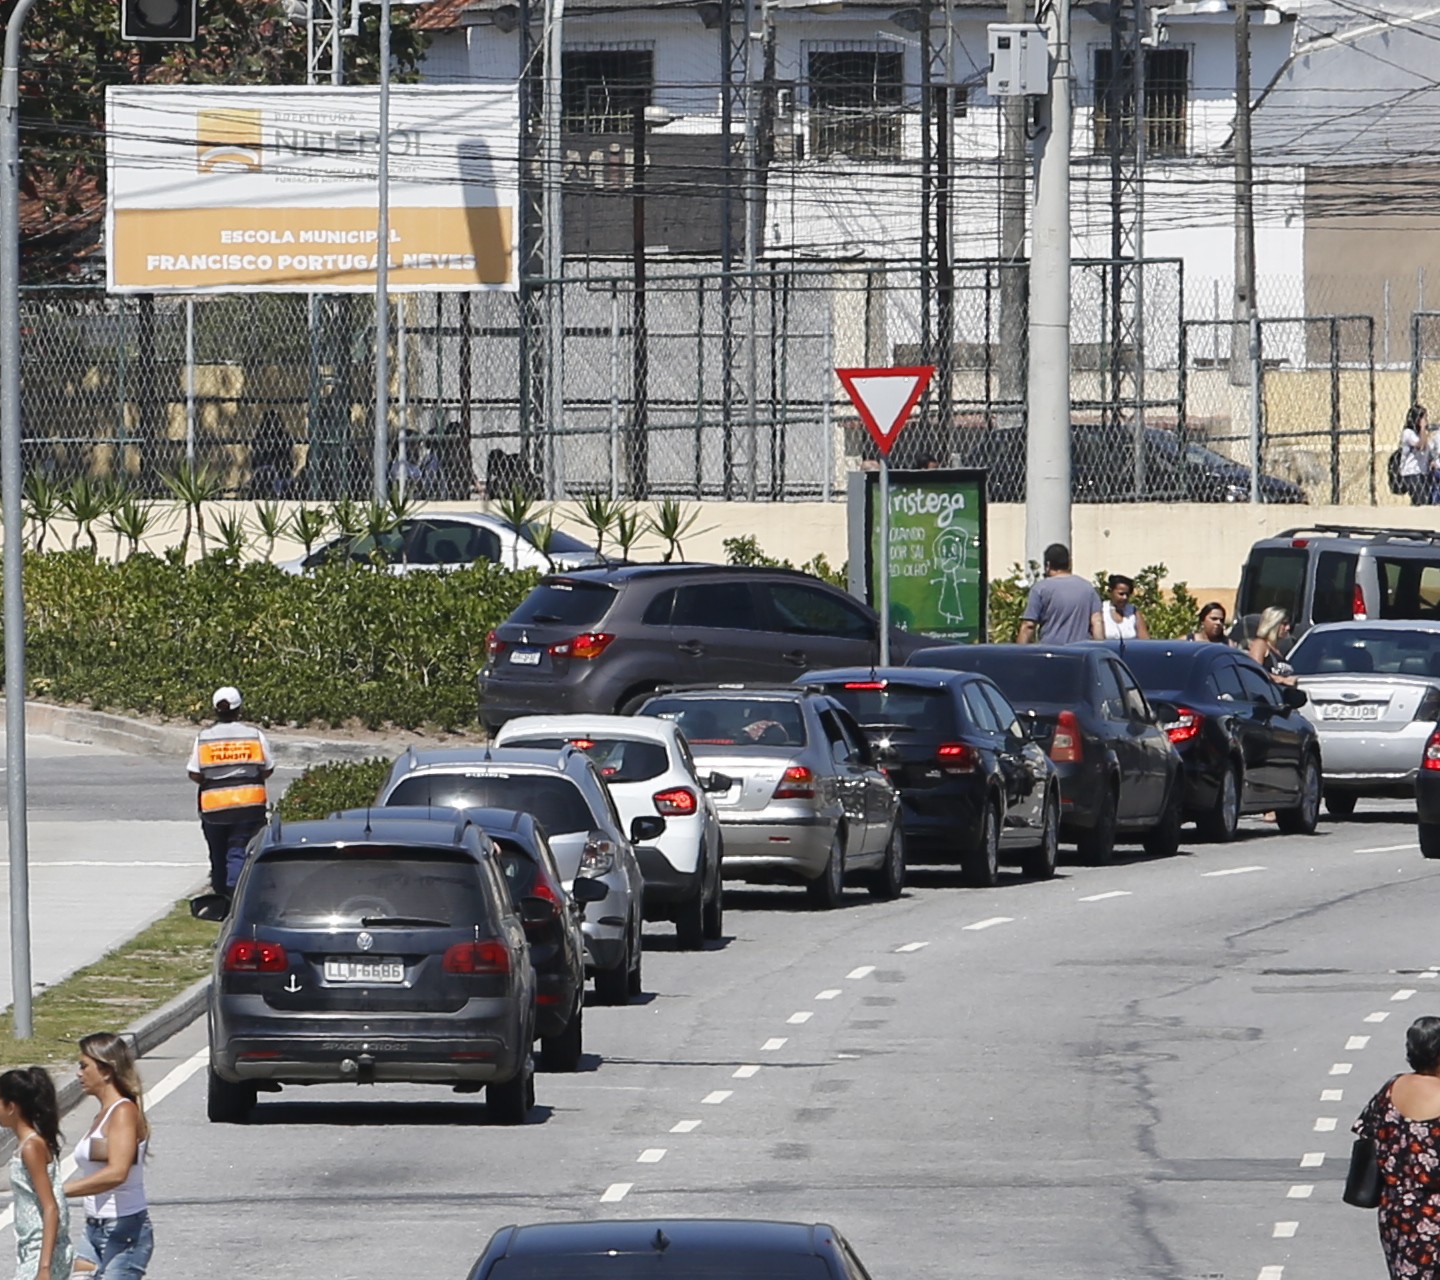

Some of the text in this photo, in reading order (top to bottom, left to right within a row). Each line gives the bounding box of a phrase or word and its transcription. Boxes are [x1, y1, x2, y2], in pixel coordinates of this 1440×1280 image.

[221, 230, 401, 244] ESCOLA MUNICIPL
[147, 254, 272, 271] FRANCISCO
[403, 253, 477, 270] NEVES
